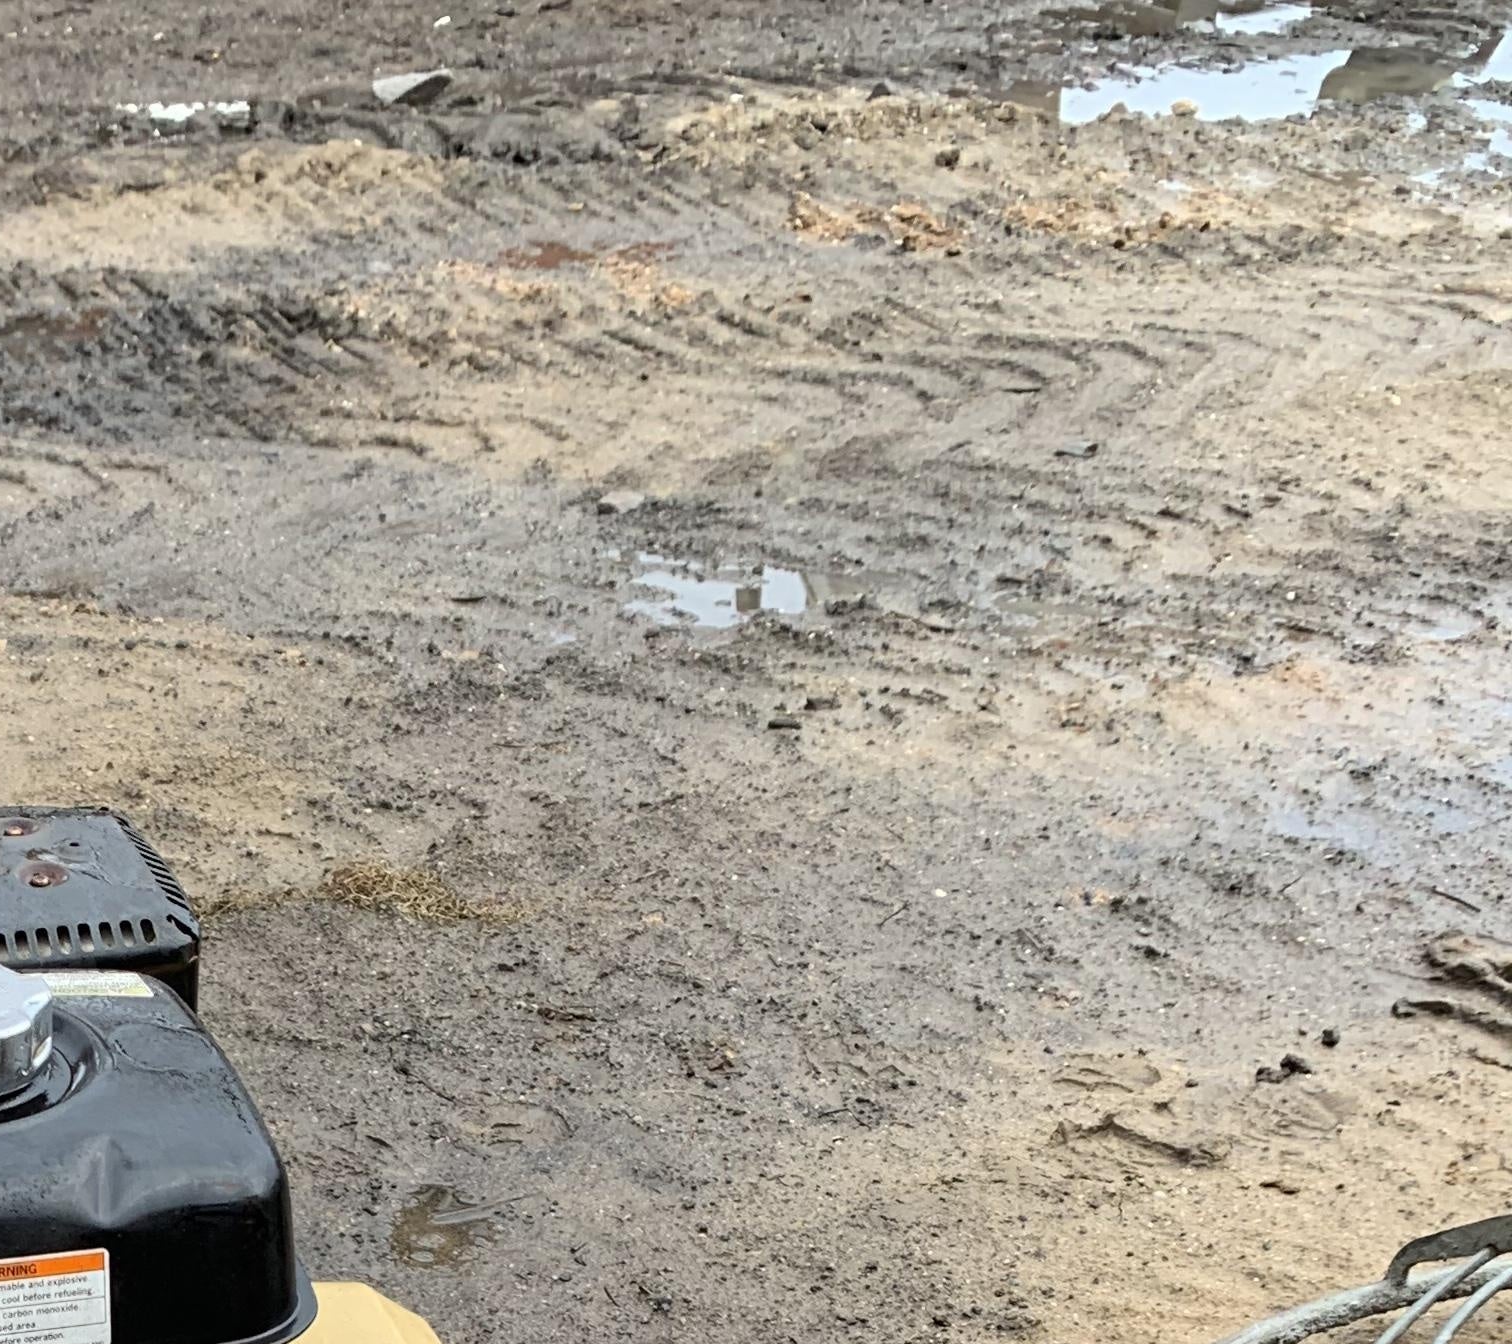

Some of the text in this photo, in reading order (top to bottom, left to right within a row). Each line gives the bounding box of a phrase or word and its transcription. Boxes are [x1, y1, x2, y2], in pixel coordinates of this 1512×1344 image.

[28, 1280, 44, 1288] and
[1, 1296, 20, 1304] cool
[23, 1292, 51, 1301] before
[2, 1310, 33, 1319] carbon
